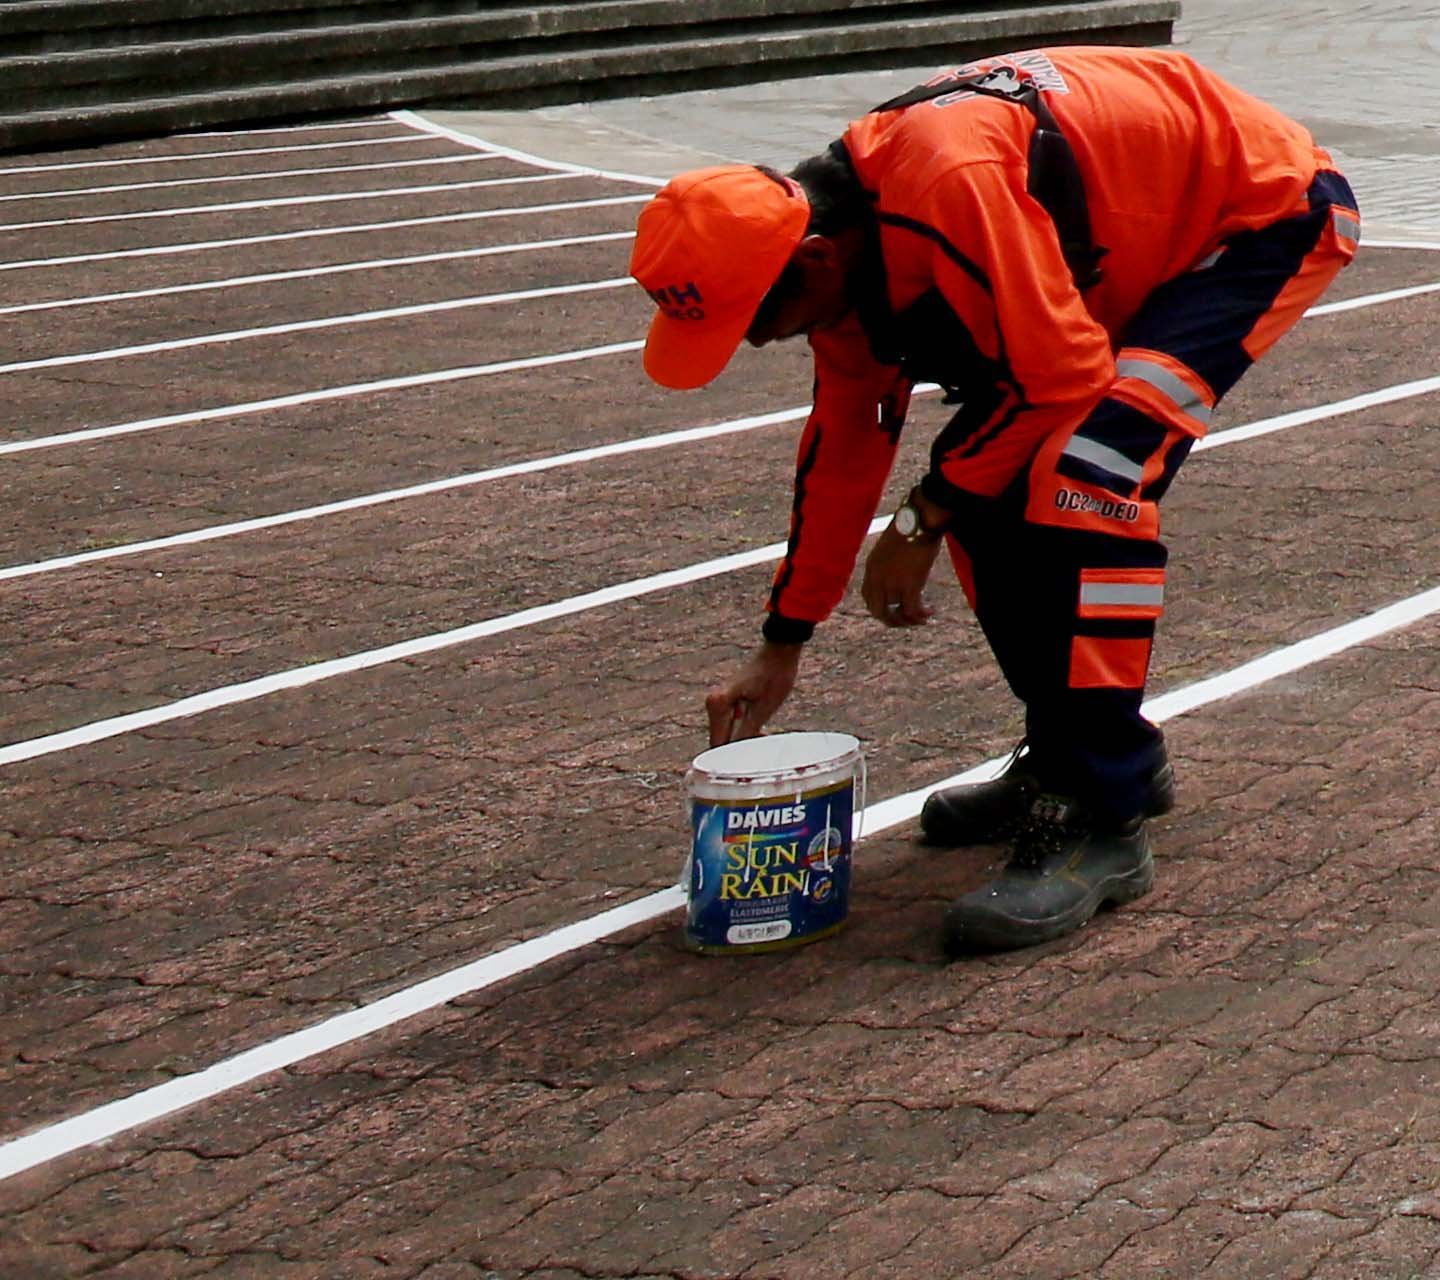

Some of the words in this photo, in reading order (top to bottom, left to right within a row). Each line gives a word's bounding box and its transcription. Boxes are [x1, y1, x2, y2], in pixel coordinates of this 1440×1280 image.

[727, 805, 806, 829] DAVIES
[726, 842, 799, 871] SUN
[719, 869, 808, 900] RAIN
